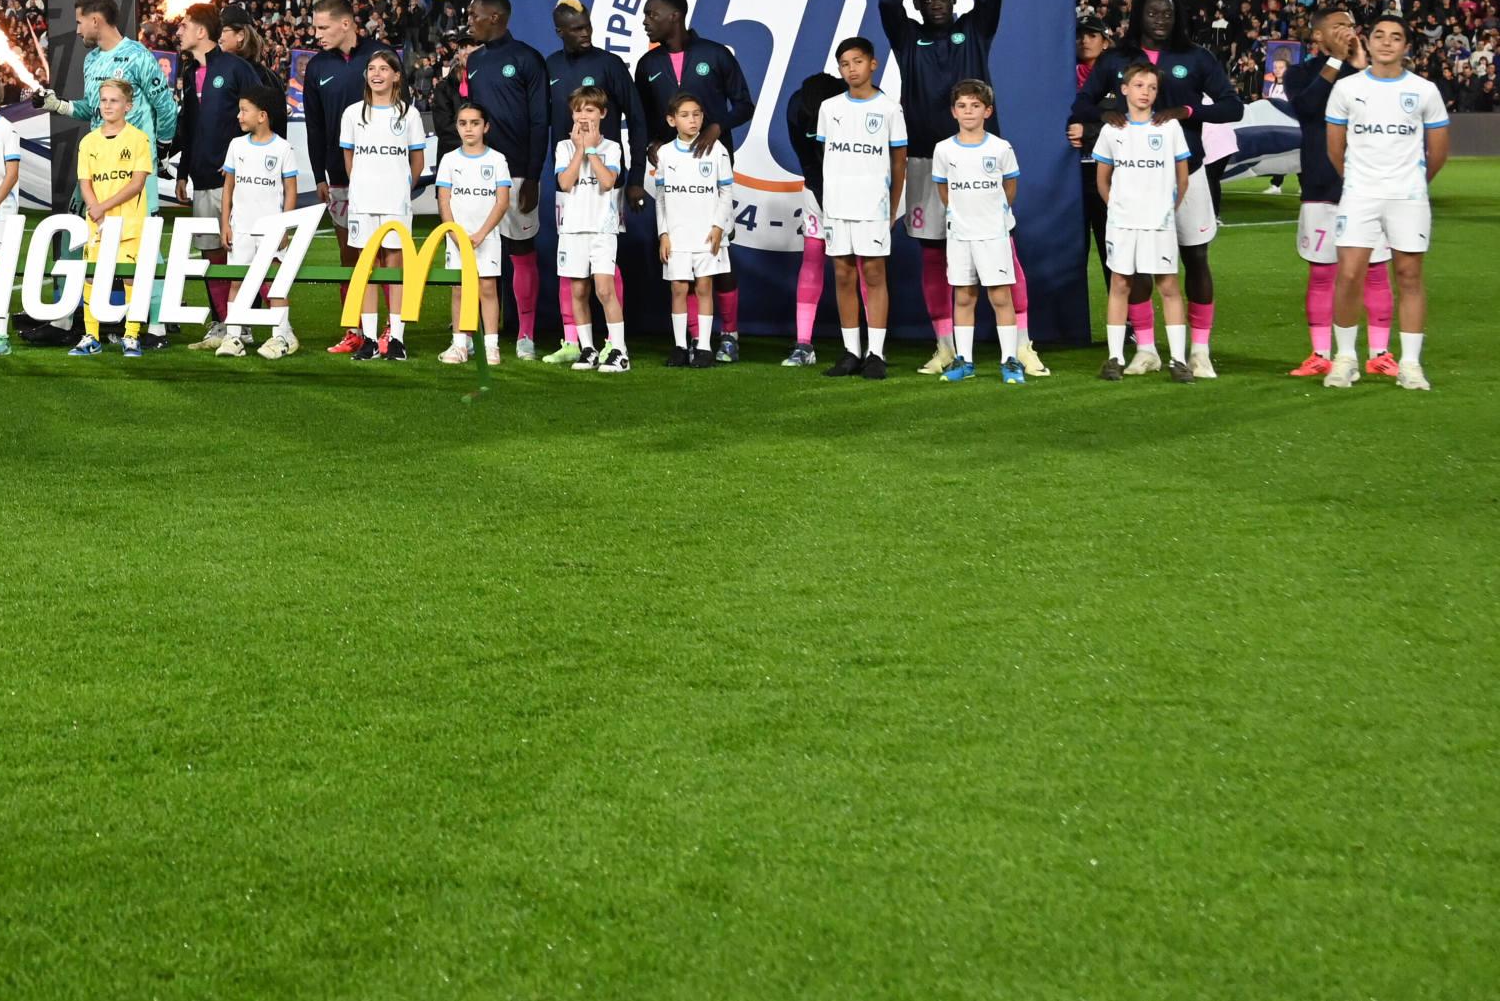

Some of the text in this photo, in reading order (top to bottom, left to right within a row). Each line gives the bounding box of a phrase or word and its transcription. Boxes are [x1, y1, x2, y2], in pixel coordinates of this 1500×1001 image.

[1354, 124, 1418, 136] CMA CGM
[379, 145, 408, 157] CGM
[853, 143, 883, 157] CGM
[1137, 159, 1165, 169] CGM
[110, 170, 133, 182] CGM
[254, 176, 276, 188] CGM
[453, 186, 497, 197] CMA CGM
[664, 185, 714, 194] CMA CGM
[951, 180, 998, 191] CMA CGM
[808, 214, 819, 235] 3
[912, 207, 924, 230] 8
[1315, 229, 1326, 252] 7
